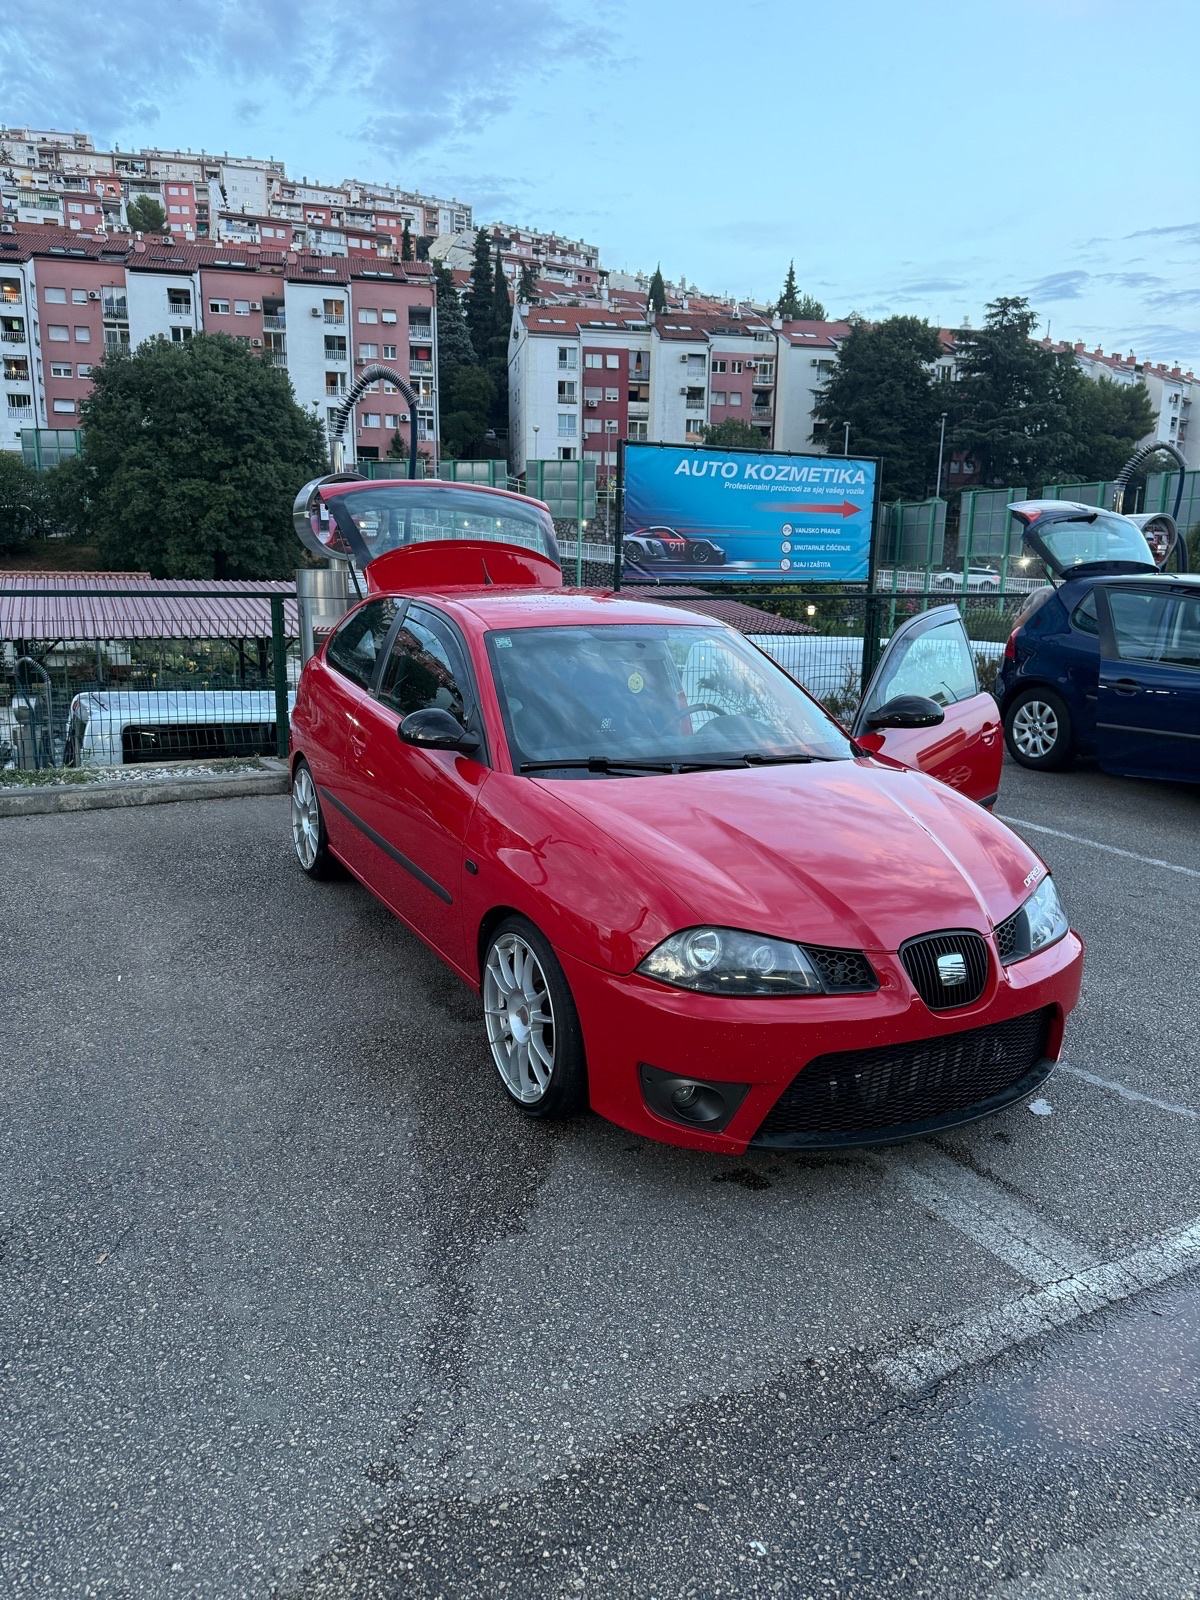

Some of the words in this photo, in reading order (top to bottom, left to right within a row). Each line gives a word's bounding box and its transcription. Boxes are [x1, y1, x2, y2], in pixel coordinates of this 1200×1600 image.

[674, 459, 738, 478] AUTO
[744, 463, 866, 484] KOZMETIKA
[724, 481, 770, 491] Profesionalni
[770, 484, 802, 493] proizvodi
[812, 486, 825, 495] sjaj
[825, 486, 844, 496] vašeg
[669, 541, 685, 552] 911
[810, 560, 831, 568] ZAŠTITA
